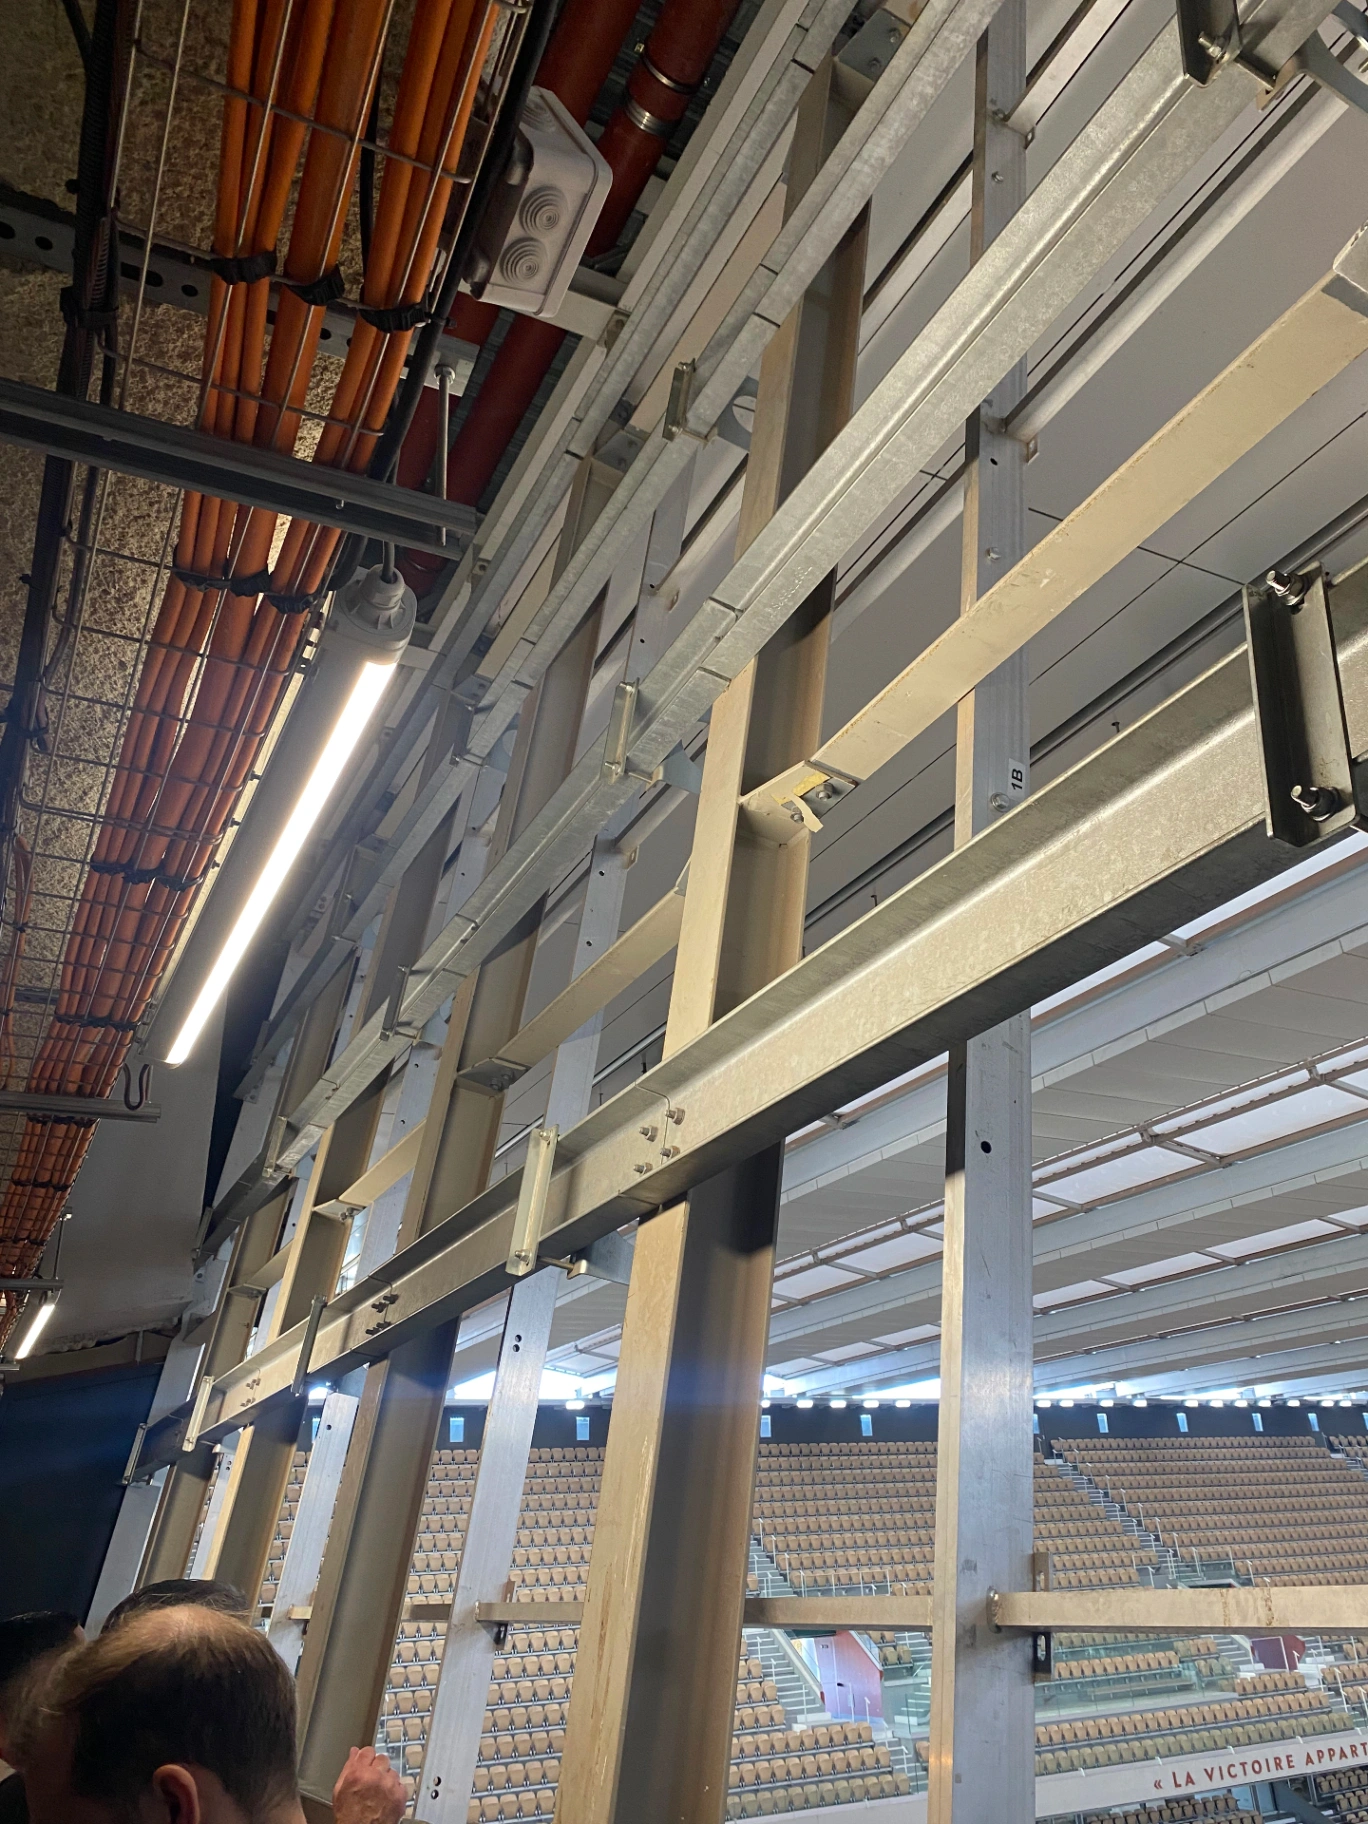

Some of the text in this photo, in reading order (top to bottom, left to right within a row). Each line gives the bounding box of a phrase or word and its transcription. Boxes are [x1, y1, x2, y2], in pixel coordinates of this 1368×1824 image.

[1011, 768, 1023, 790] 1B
[1171, 1770, 1196, 1788] LA
[1203, 1754, 1296, 1782] VICTOIRE
[1305, 1742, 1368, 1766] APPART
